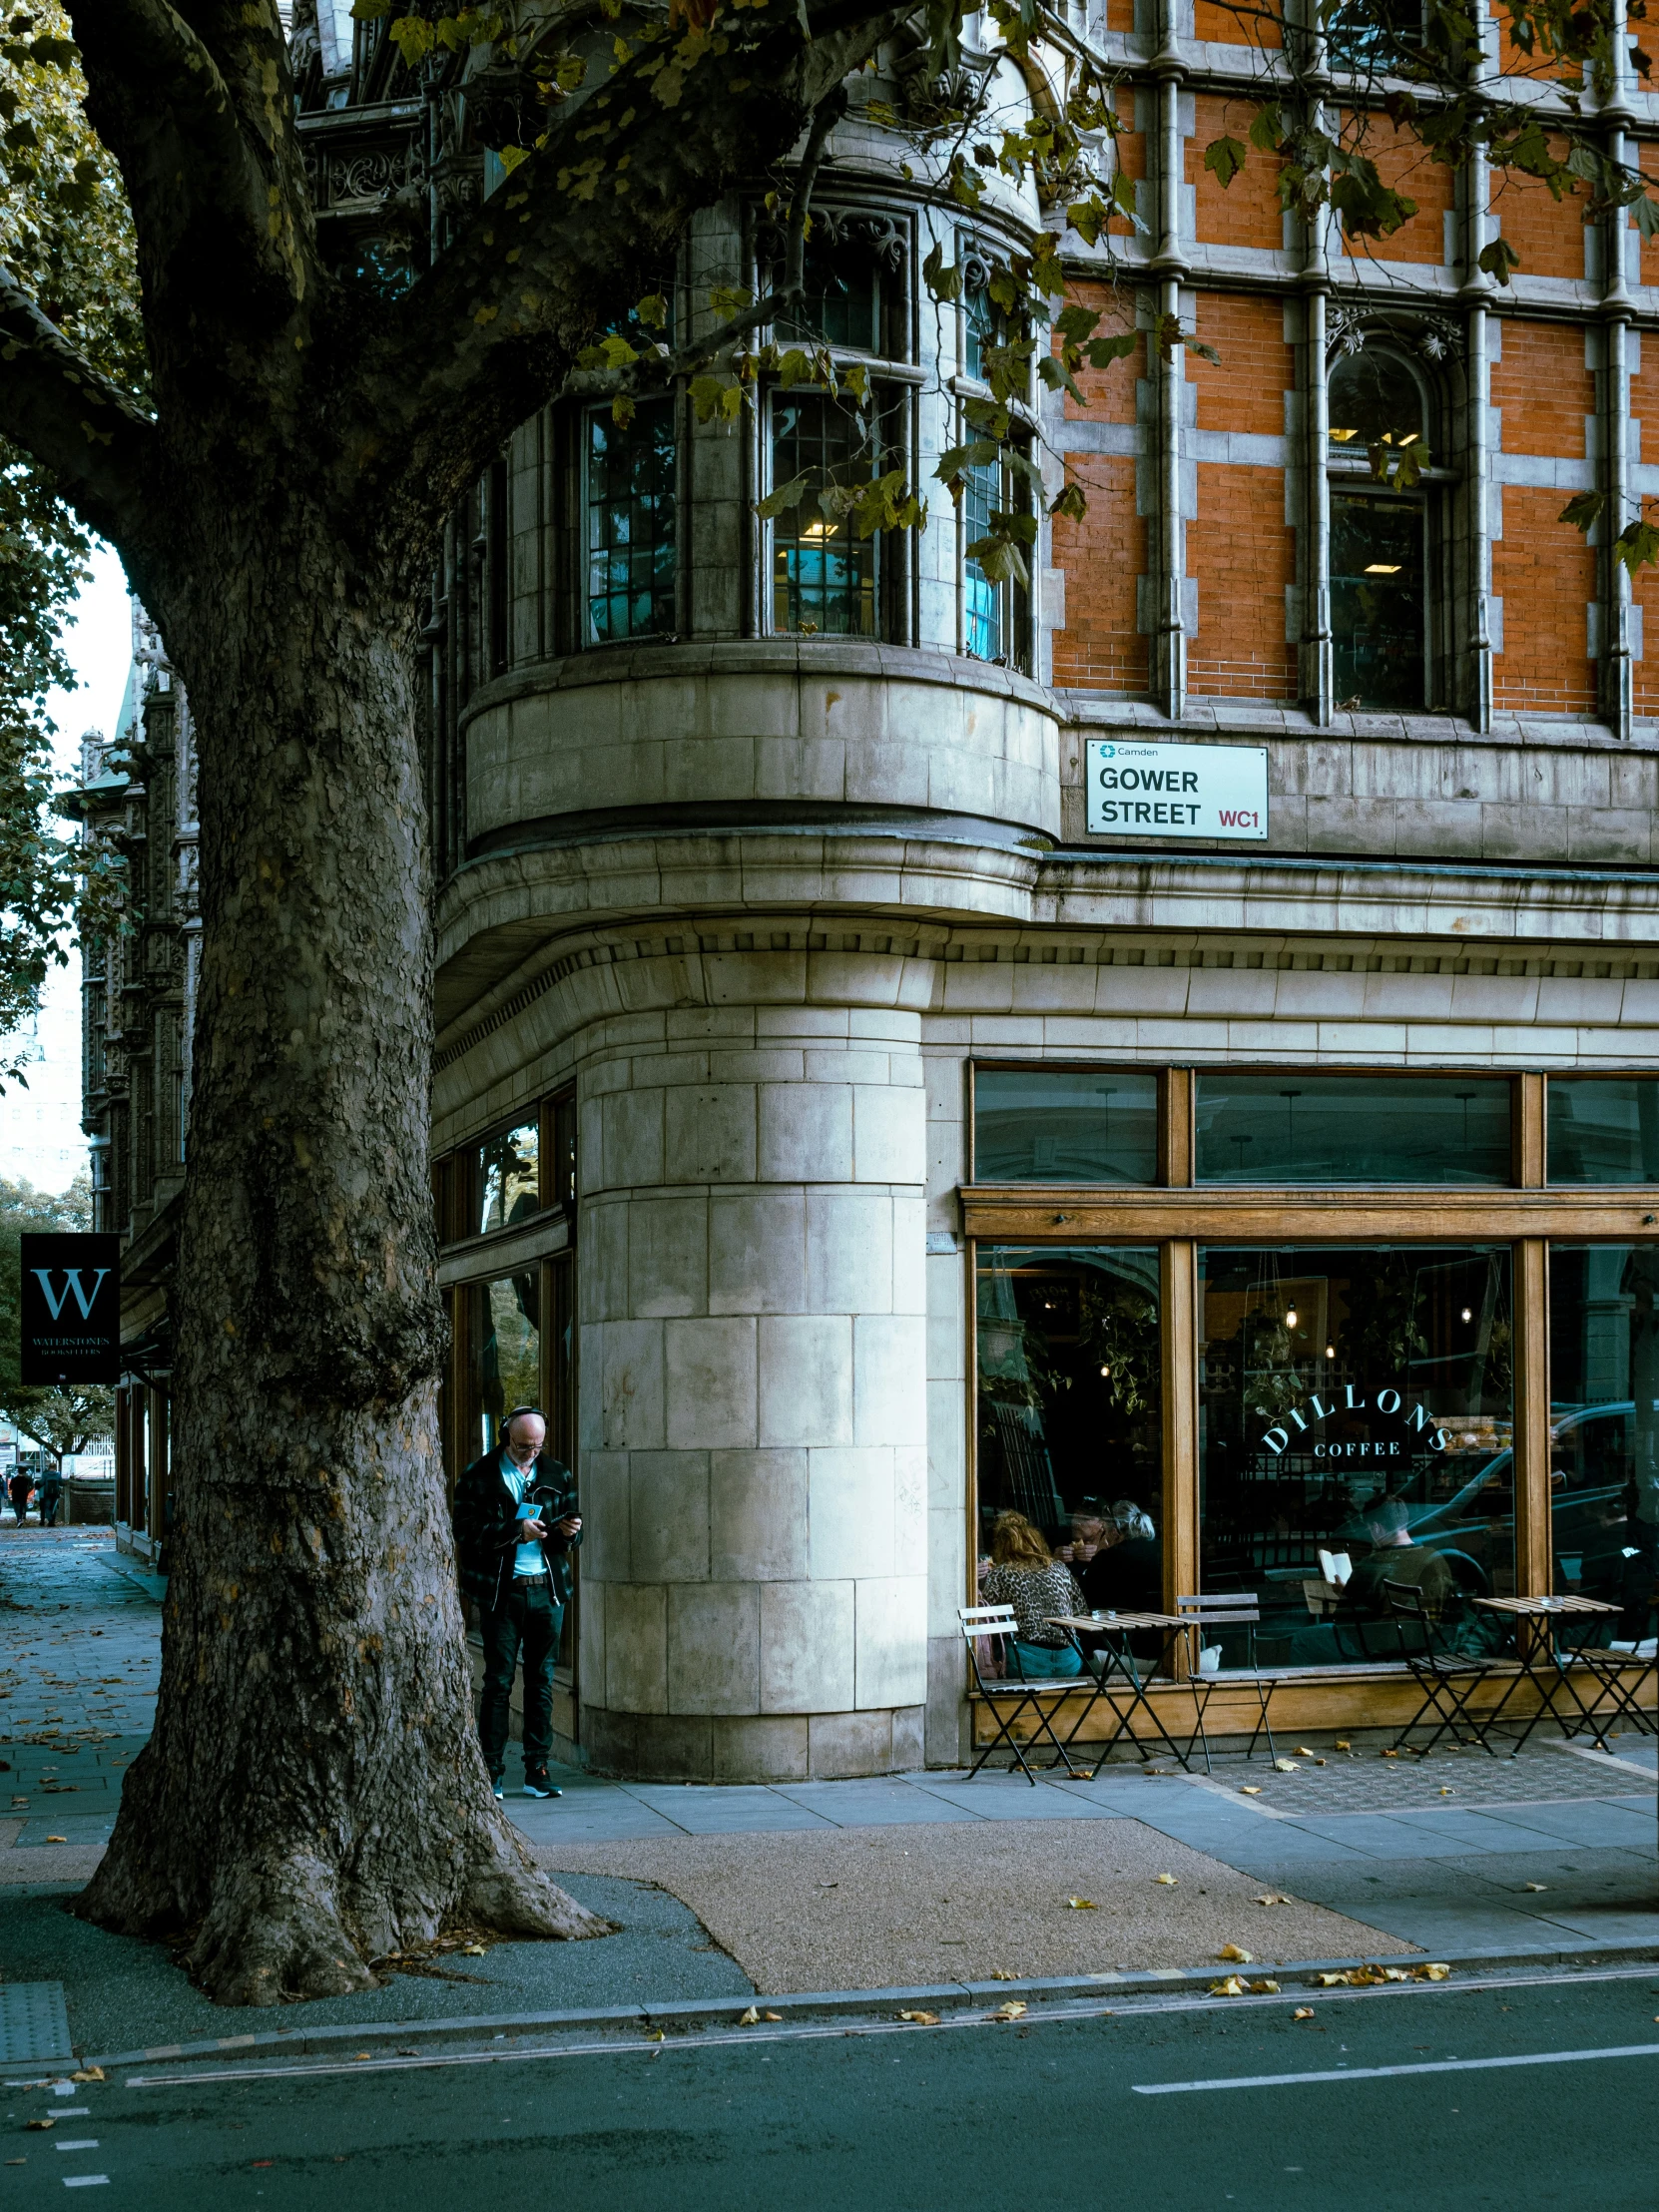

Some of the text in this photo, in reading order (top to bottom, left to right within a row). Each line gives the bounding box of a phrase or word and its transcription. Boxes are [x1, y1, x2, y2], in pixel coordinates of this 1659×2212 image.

[1117, 747, 1159, 757] Camden
[1099, 767, 1199, 793] GOWER
[1101, 800, 1202, 826] STREET
[1218, 810, 1259, 829] WC1
[30, 1268, 112, 1321] W
[32, 1337, 110, 1347] WATERSTONES
[1261, 1383, 1453, 1456] DILLONS
[1314, 1441, 1400, 1457] COFFEE
